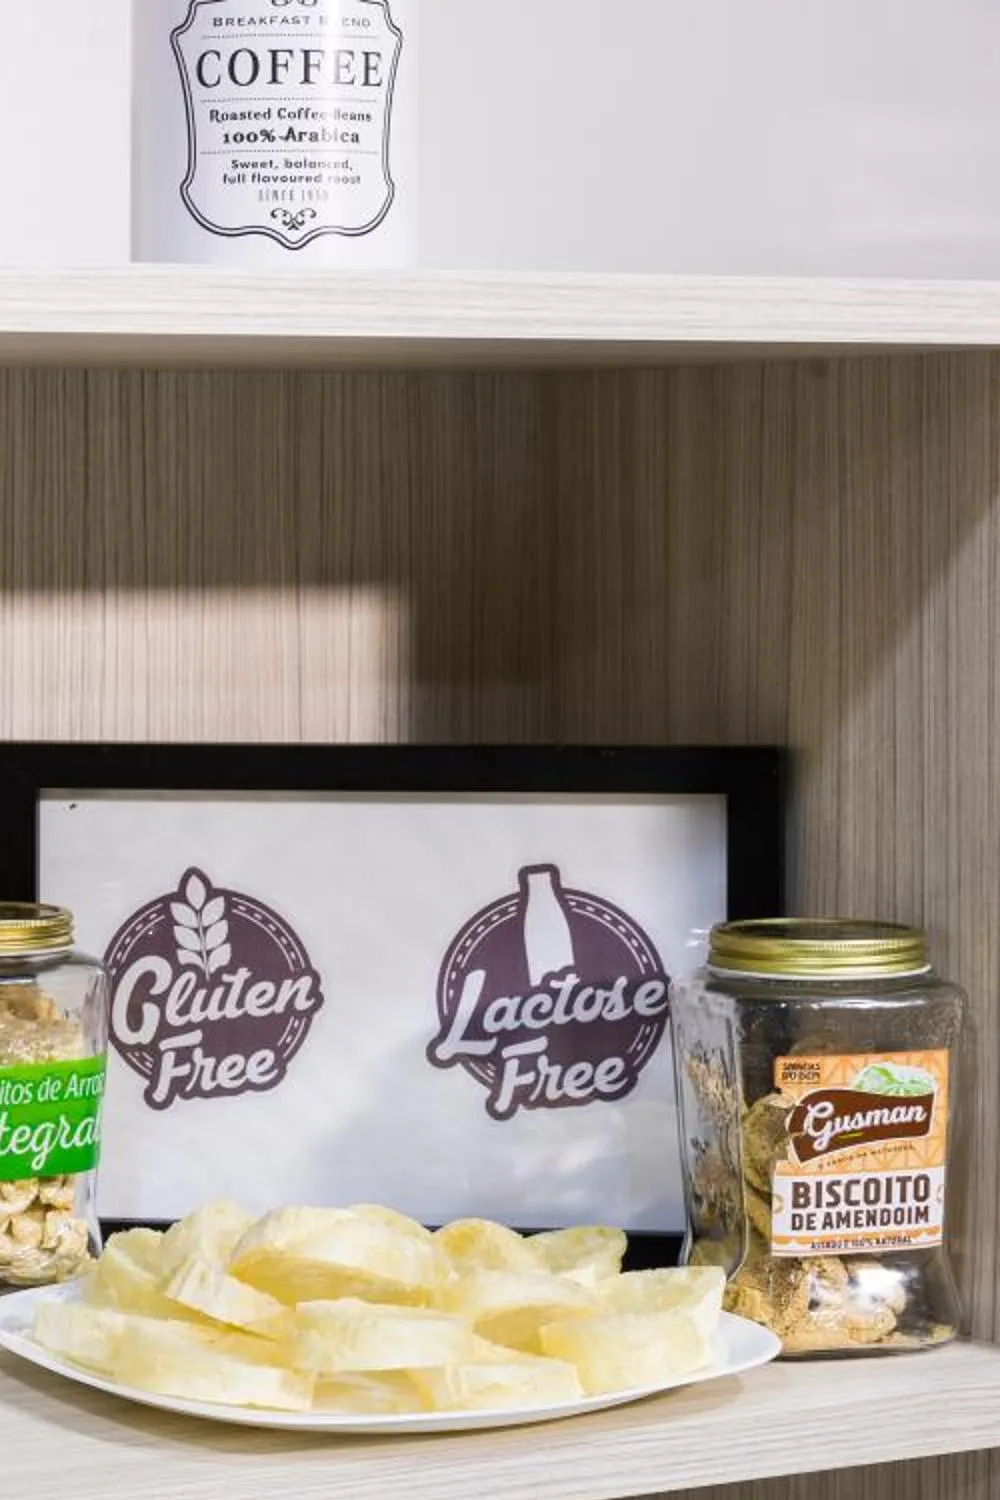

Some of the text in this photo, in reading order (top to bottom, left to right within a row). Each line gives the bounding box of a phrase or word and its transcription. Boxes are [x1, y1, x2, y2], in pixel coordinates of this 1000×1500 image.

[213, 16, 311, 28] BREAKFAST
[196, 48, 383, 88] COFFEE
[209, 108, 271, 123] Roasted
[277, 108, 327, 121] Coffee
[222, 126, 360, 144] 100% Arabica
[223, 174, 361, 185] full flavoured roast
[231, 158, 353, 172] Sweet, balanced,
[111, 955, 316, 1046] Gluten
[436, 969, 670, 1058] Lactose
[154, 1029, 280, 1100] Free
[495, 1035, 628, 1110] Free
[38, 1076, 61, 1103] de
[64, 1071, 105, 1099] Arro
[804, 1101, 926, 1150] Gusman
[791, 1173, 930, 1210] BISCOITO
[791, 1205, 929, 1231] DE AMENDOIM
